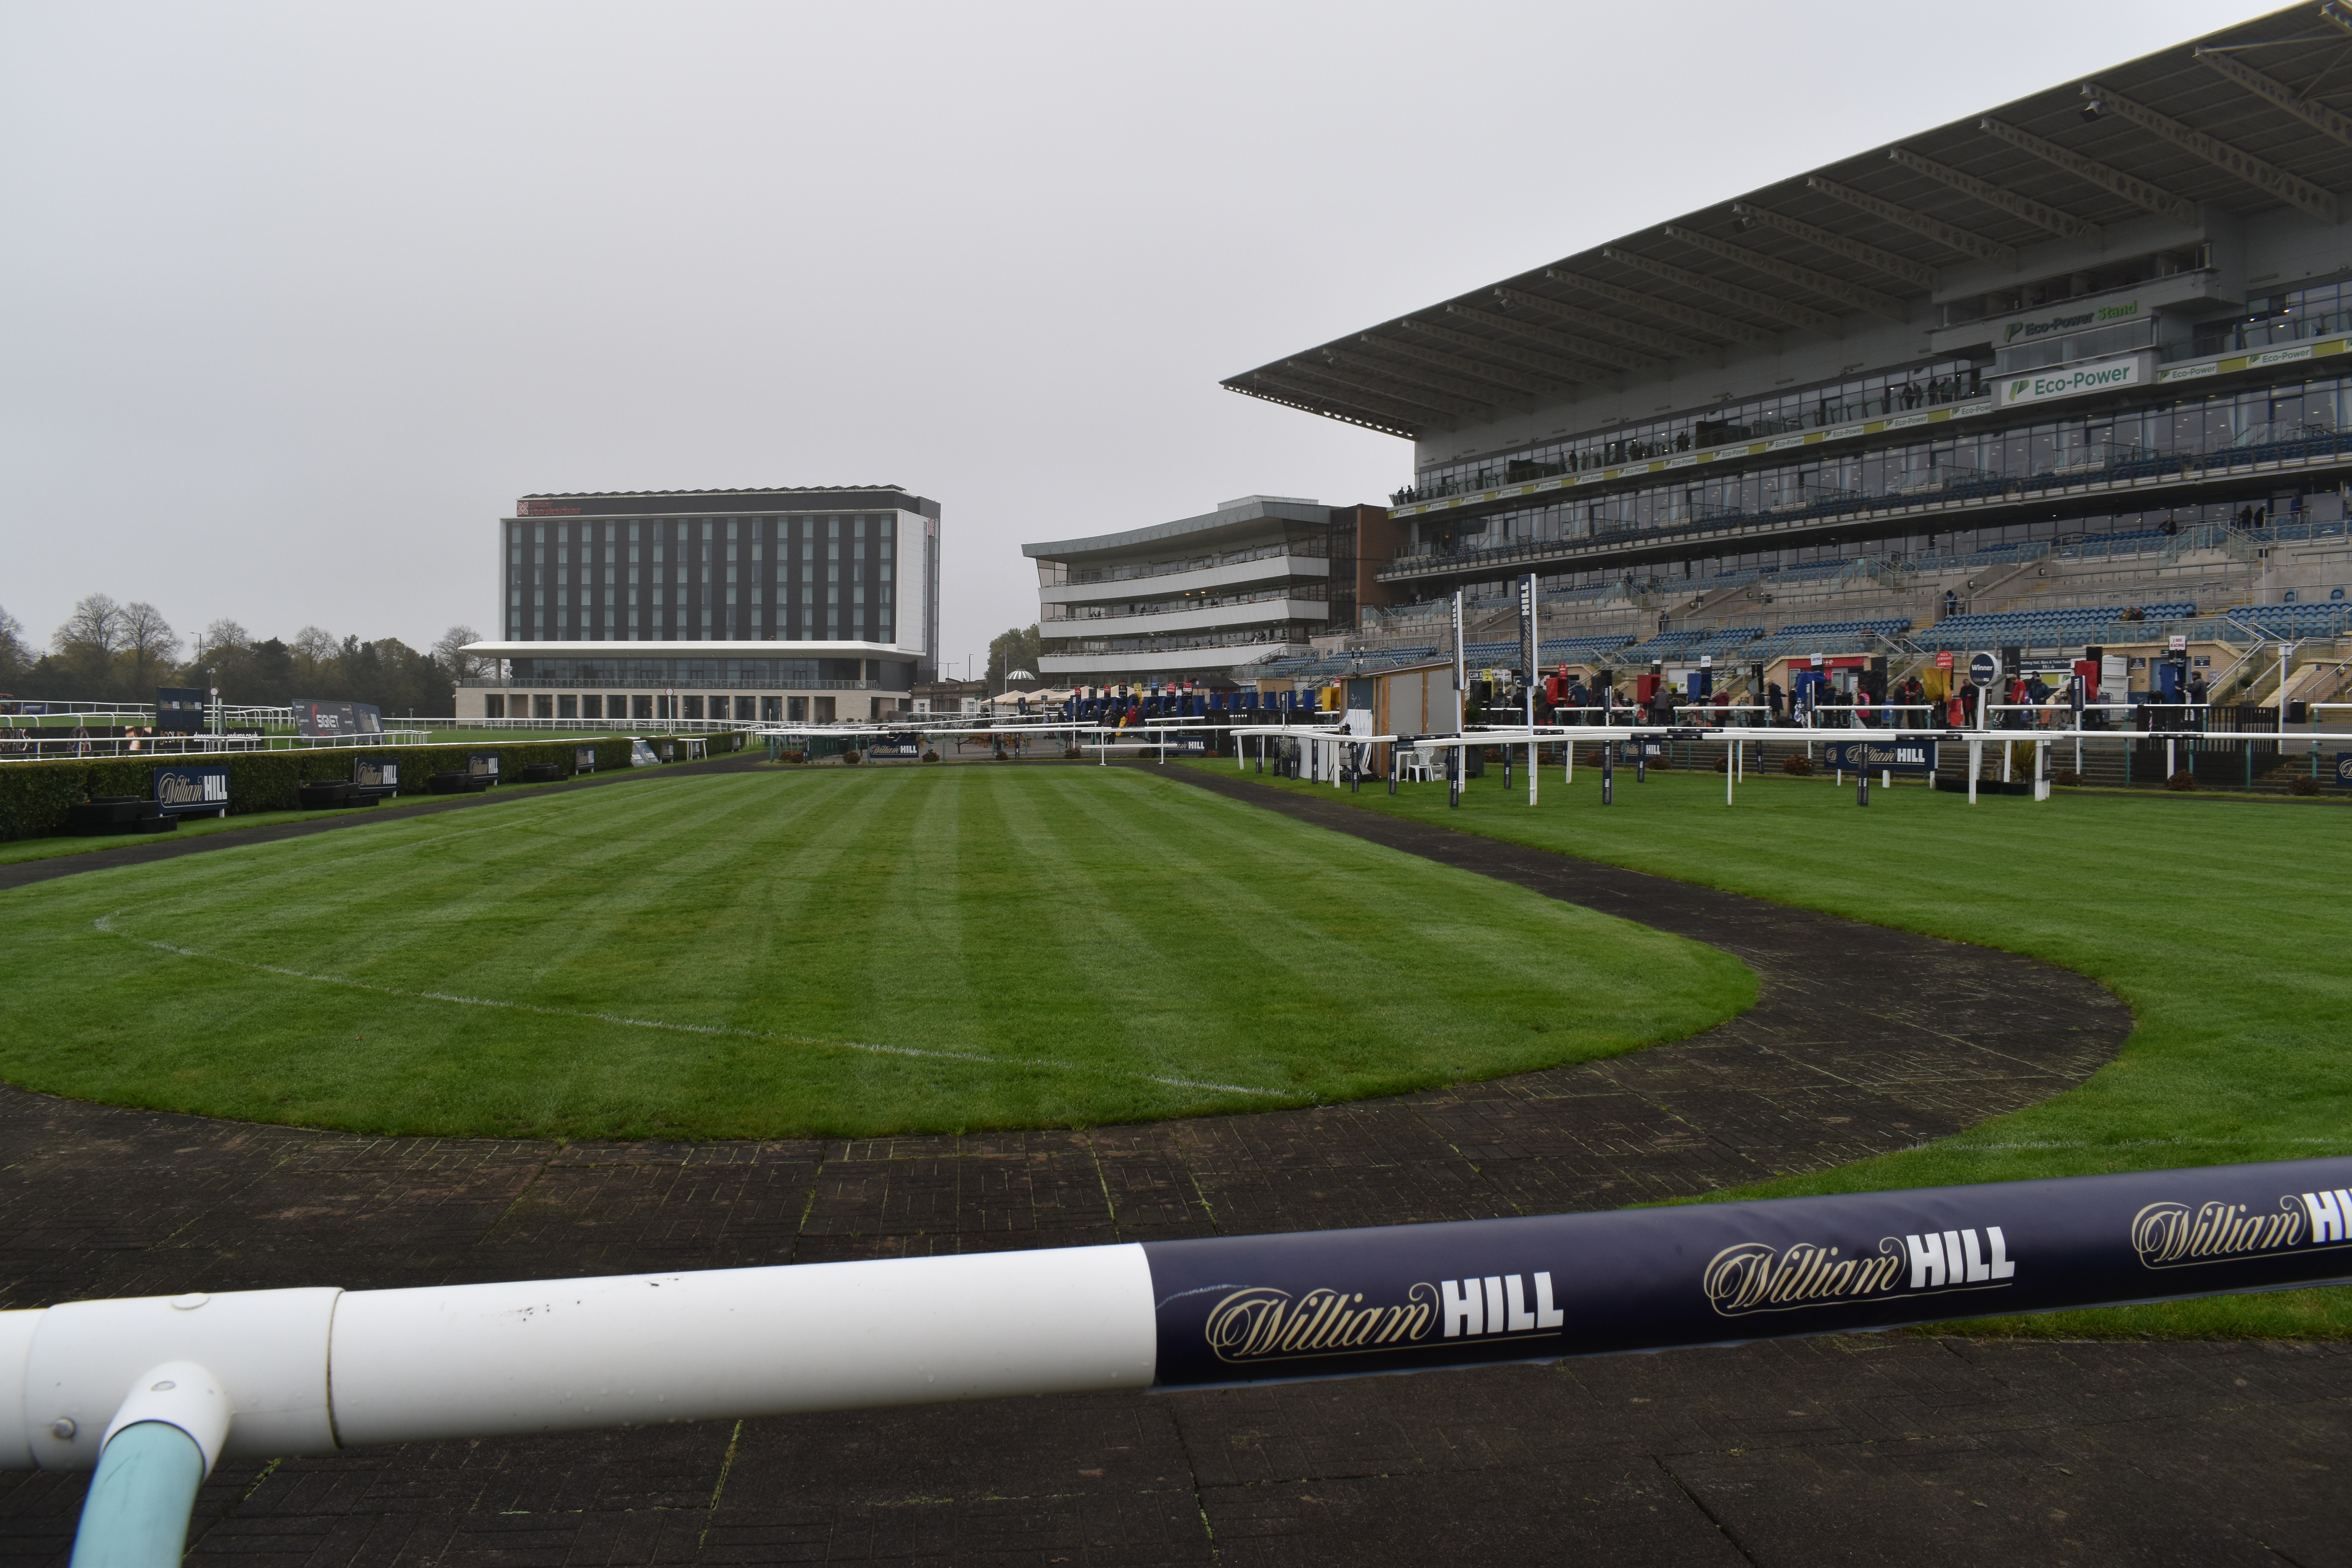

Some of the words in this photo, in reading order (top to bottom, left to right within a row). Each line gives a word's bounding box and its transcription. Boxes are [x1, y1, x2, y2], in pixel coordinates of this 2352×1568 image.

[2025, 312, 2094, 336] Eco-Power
[2097, 300, 2138, 320] Stand
[2263, 350, 2310, 363] Eco-Power
[2172, 365, 2216, 379] Eco-Power
[2035, 366, 2130, 396] Eco-Power
[1895, 416, 1927, 426] Eco-Power
[1833, 427, 1863, 437] Eco-Power
[1776, 437, 1803, 448] Eco-Power
[1722, 448, 1748, 457] Eco-Power
[1672, 457, 1697, 466] Eco-Power
[1521, 582, 1529, 616] HILL
[1523, 617, 1532, 678] William
[316, 714, 339, 728] SIGNET
[870, 744, 900, 754] William
[900, 745, 917, 753] HILL
[1646, 744, 1661, 755] HILL
[1897, 748, 1925, 762] HILL
[488, 758, 498, 774] HILL
[358, 762, 383, 786] William
[383, 765, 397, 784] HILL
[158, 773, 204, 804] William
[204, 775, 227, 801] HILL
[2132, 1195, 2307, 1263] William
[2302, 1188, 2352, 1243] HI
[1704, 1236, 1907, 1311] William
[1906, 1226, 2015, 1289] HILL
[1205, 1282, 1439, 1358] William
[1441, 1271, 1564, 1338] HILL
